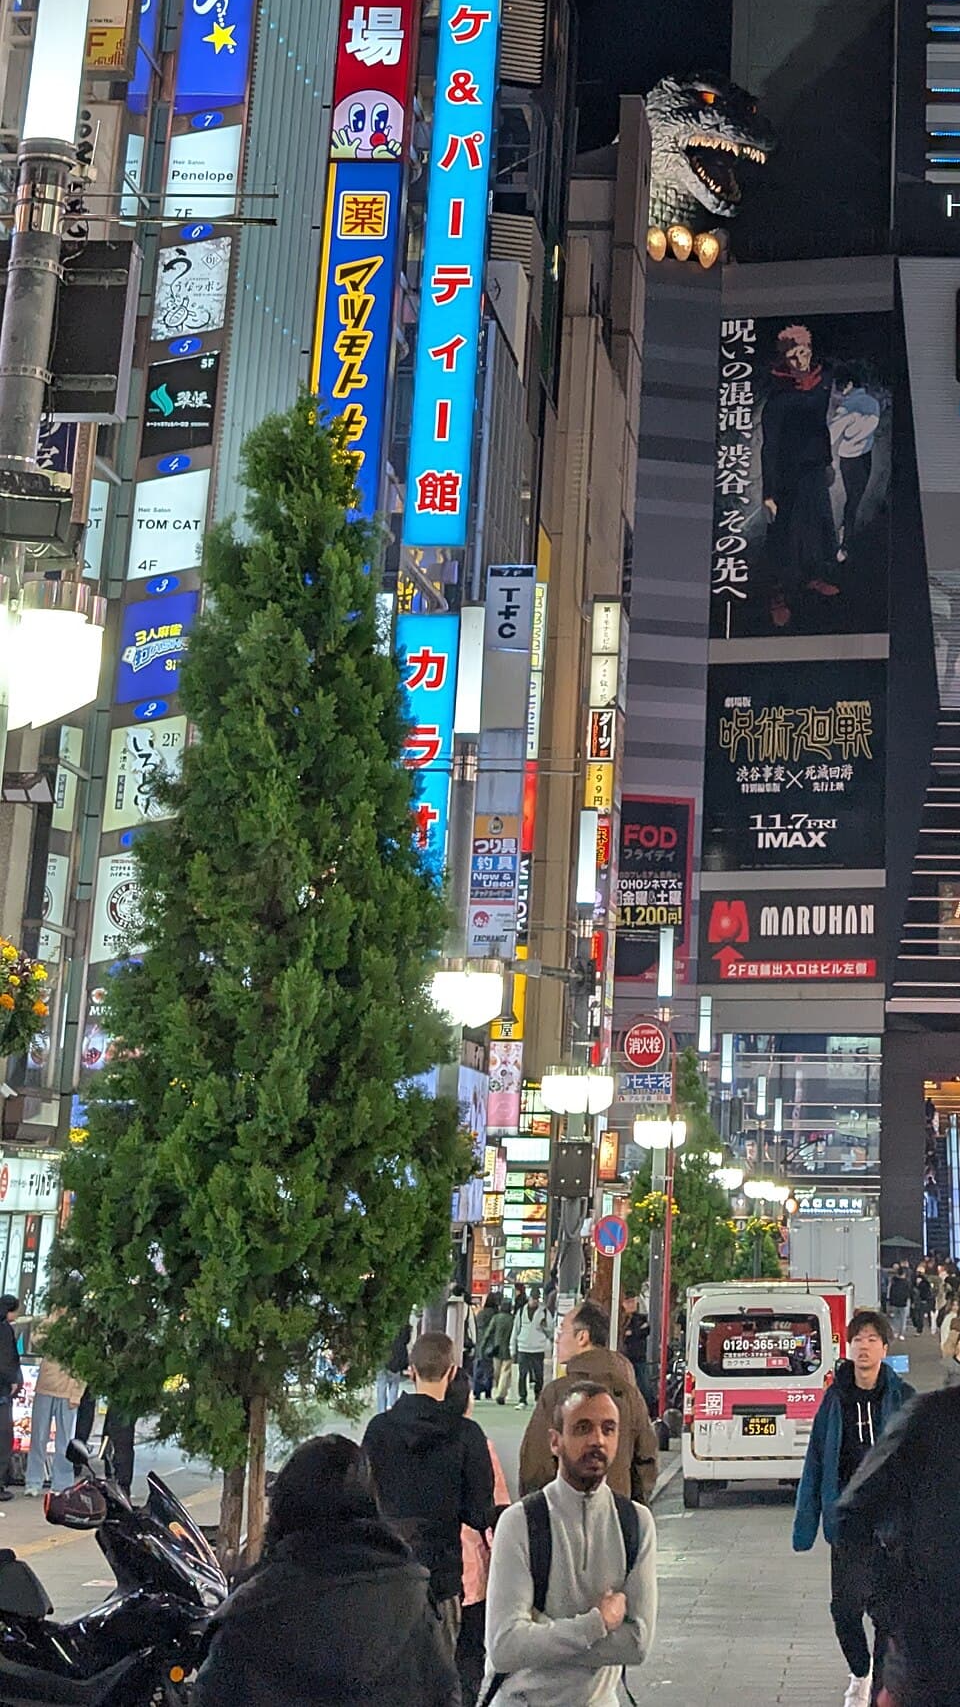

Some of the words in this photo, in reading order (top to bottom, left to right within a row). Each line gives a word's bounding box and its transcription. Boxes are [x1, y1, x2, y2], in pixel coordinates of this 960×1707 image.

[172, 170, 234, 182] Penelope
[341, 195, 387, 235] 薬
[200, 359, 214, 369] 5F
[137, 519, 168, 530] TOM
[172, 519, 200, 531] CAT
[138, 560, 158, 571] 4F
[162, 732, 181, 747] 2F
[624, 825, 678, 849] FOD
[758, 831, 827, 848] IMAX
[475, 838, 517, 854] つり具
[760, 904, 875, 936] MARUHAN
[628, 1037, 662, 1054] 消火栓
[800, 1198, 863, 1208] ACORN
[787, 1394, 816, 1402] カクヤス
